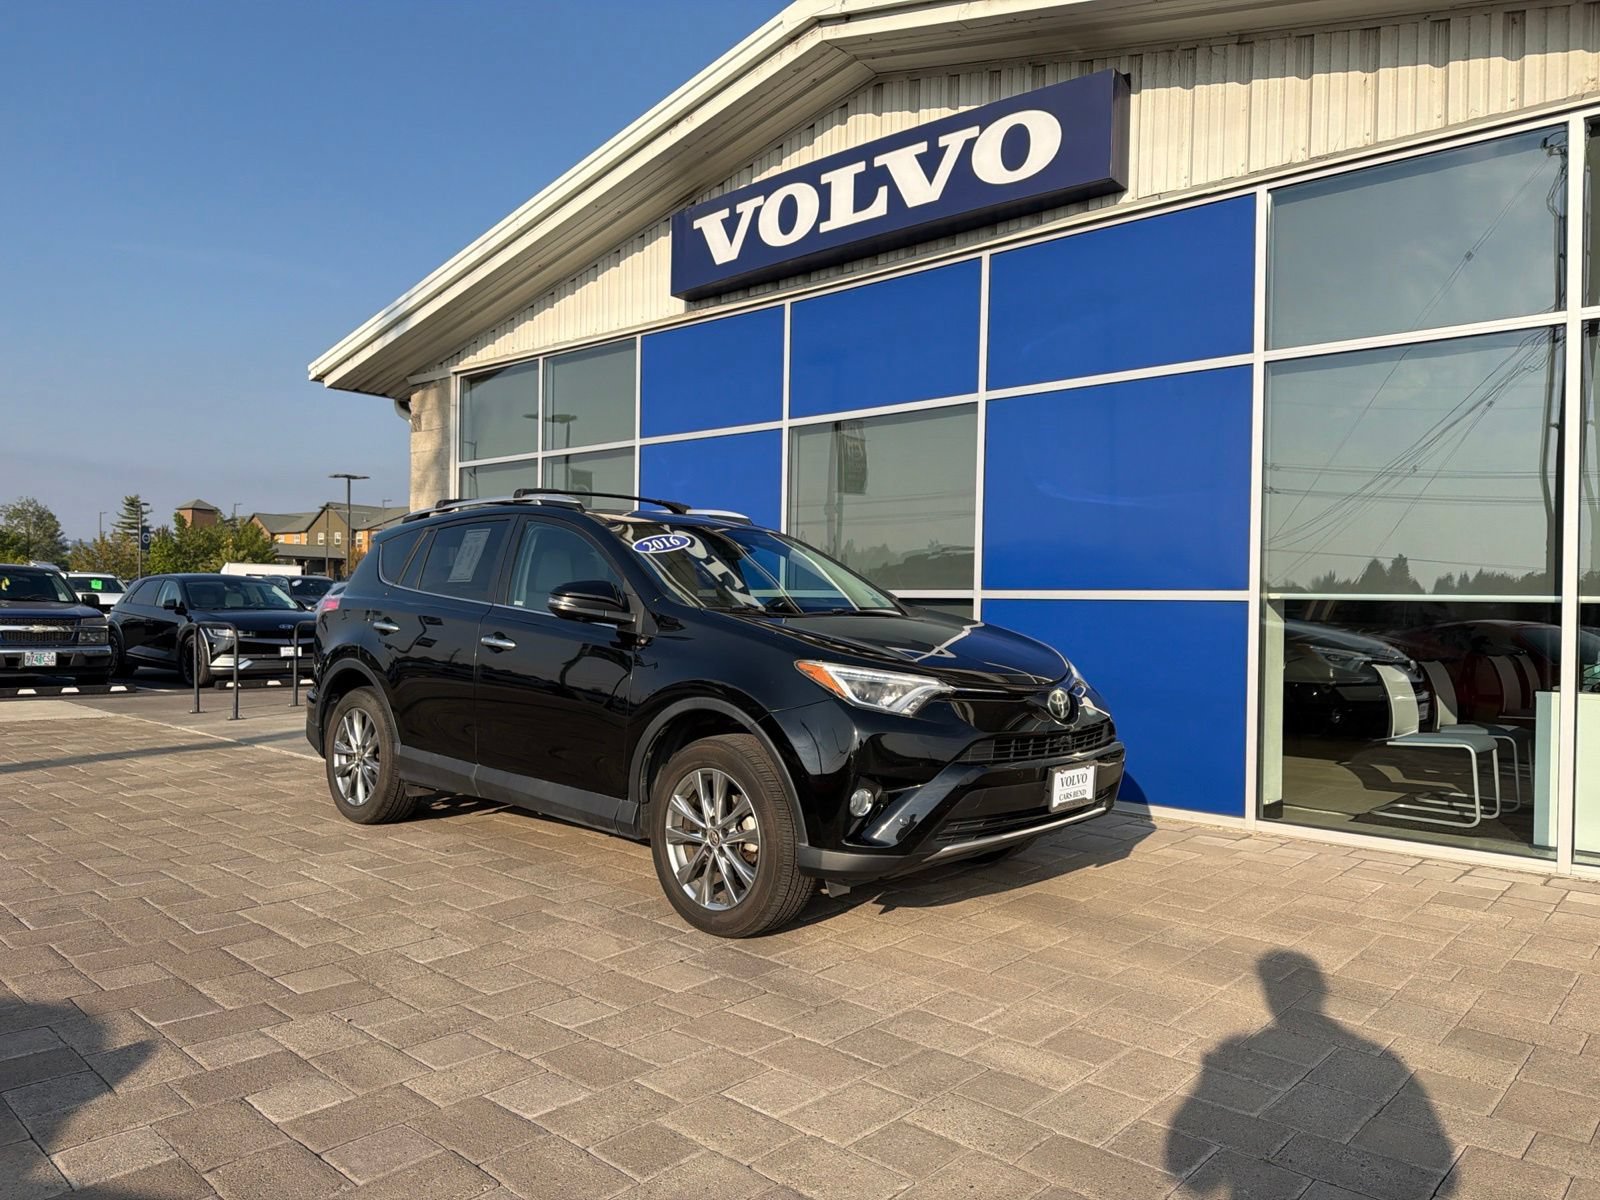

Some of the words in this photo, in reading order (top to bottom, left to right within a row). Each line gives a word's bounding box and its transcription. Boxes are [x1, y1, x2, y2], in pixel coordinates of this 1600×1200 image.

[693, 110, 1062, 265] VOLVO
[642, 536, 681, 552] 2016
[1060, 773, 1088, 788] VOLVO
[1059, 791, 1073, 801] CARS
[1073, 789, 1087, 799] BEND
